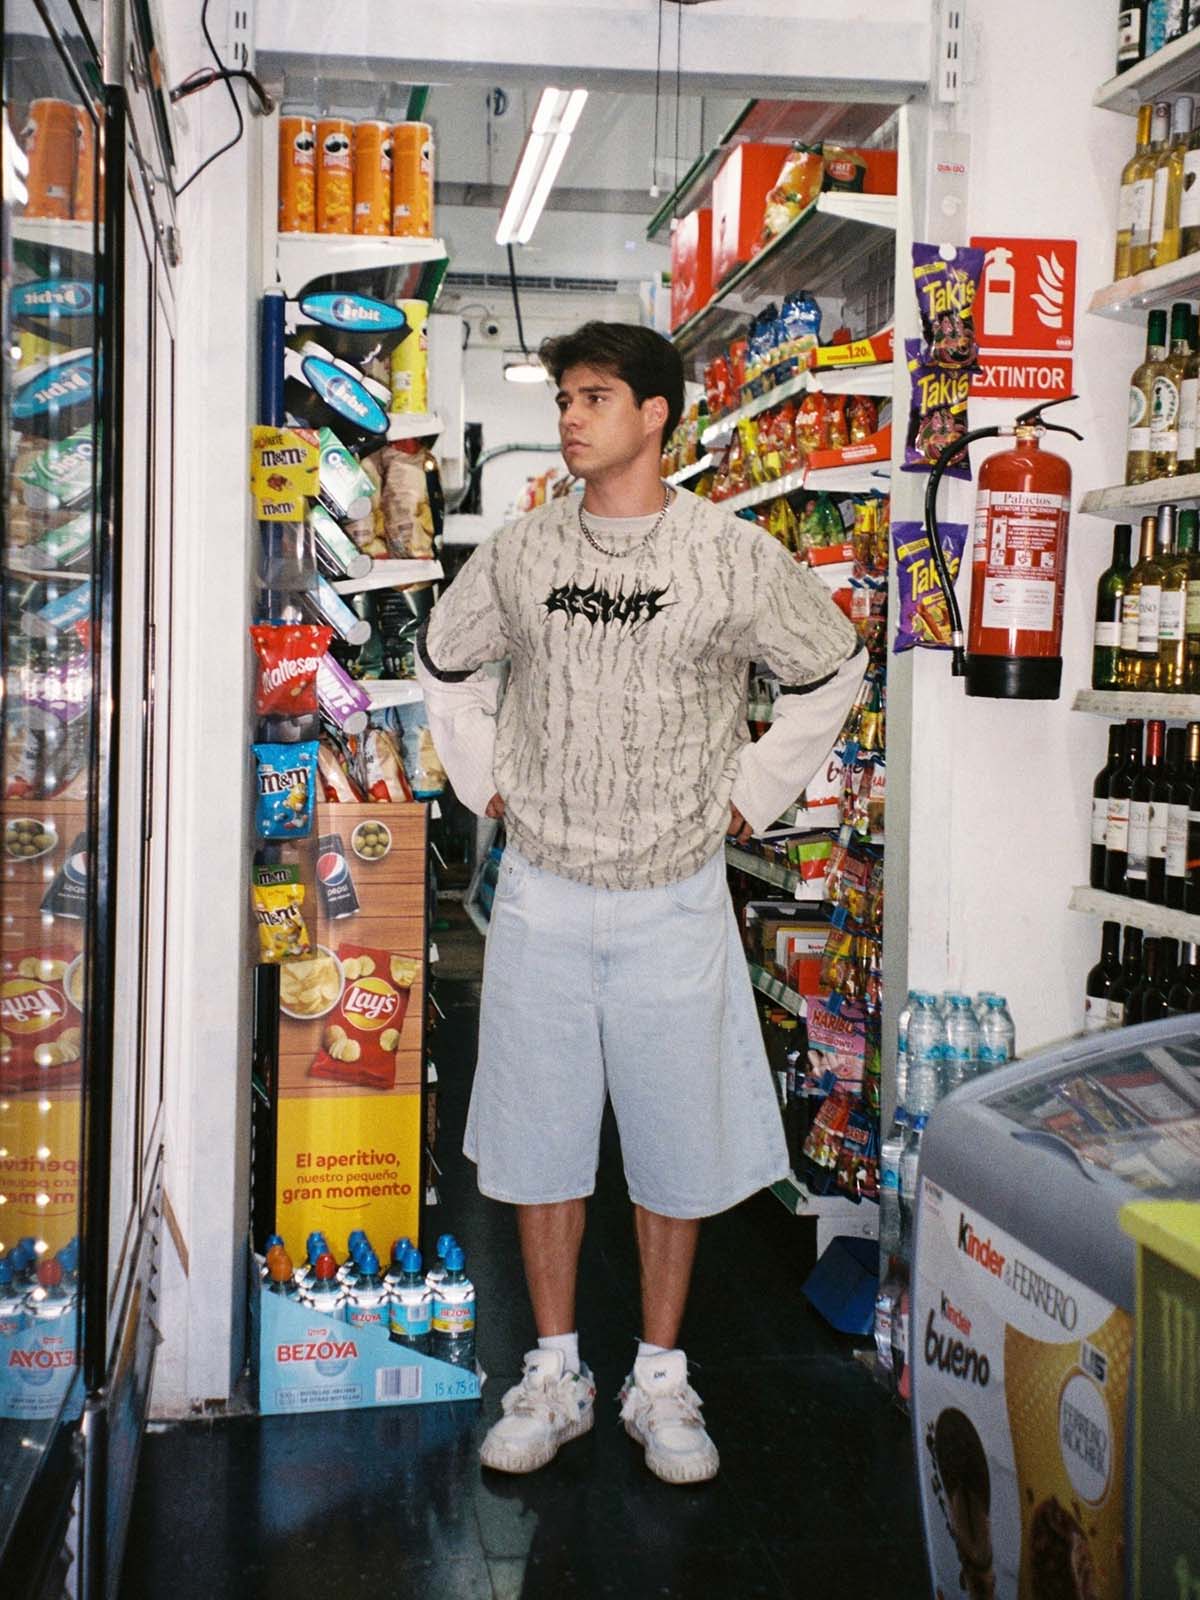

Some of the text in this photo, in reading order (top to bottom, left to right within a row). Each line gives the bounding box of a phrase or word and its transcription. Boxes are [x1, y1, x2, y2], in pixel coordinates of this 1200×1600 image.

[923, 280, 975, 321] Takis
[972, 365, 1065, 389] EXTINTOR
[917, 373, 969, 414] Takis
[906, 556, 960, 602] Taks
[344, 987, 397, 1019] Lay's
[296, 1149, 400, 1170] El aperitivo,
[297, 1169, 398, 1184] nuestro pequeño
[282, 1182, 412, 1205] gran momento
[1013, 1258, 1077, 1332] FERRERO
[277, 1340, 358, 1363] BEZOYA
[925, 1308, 990, 1389] bueno
